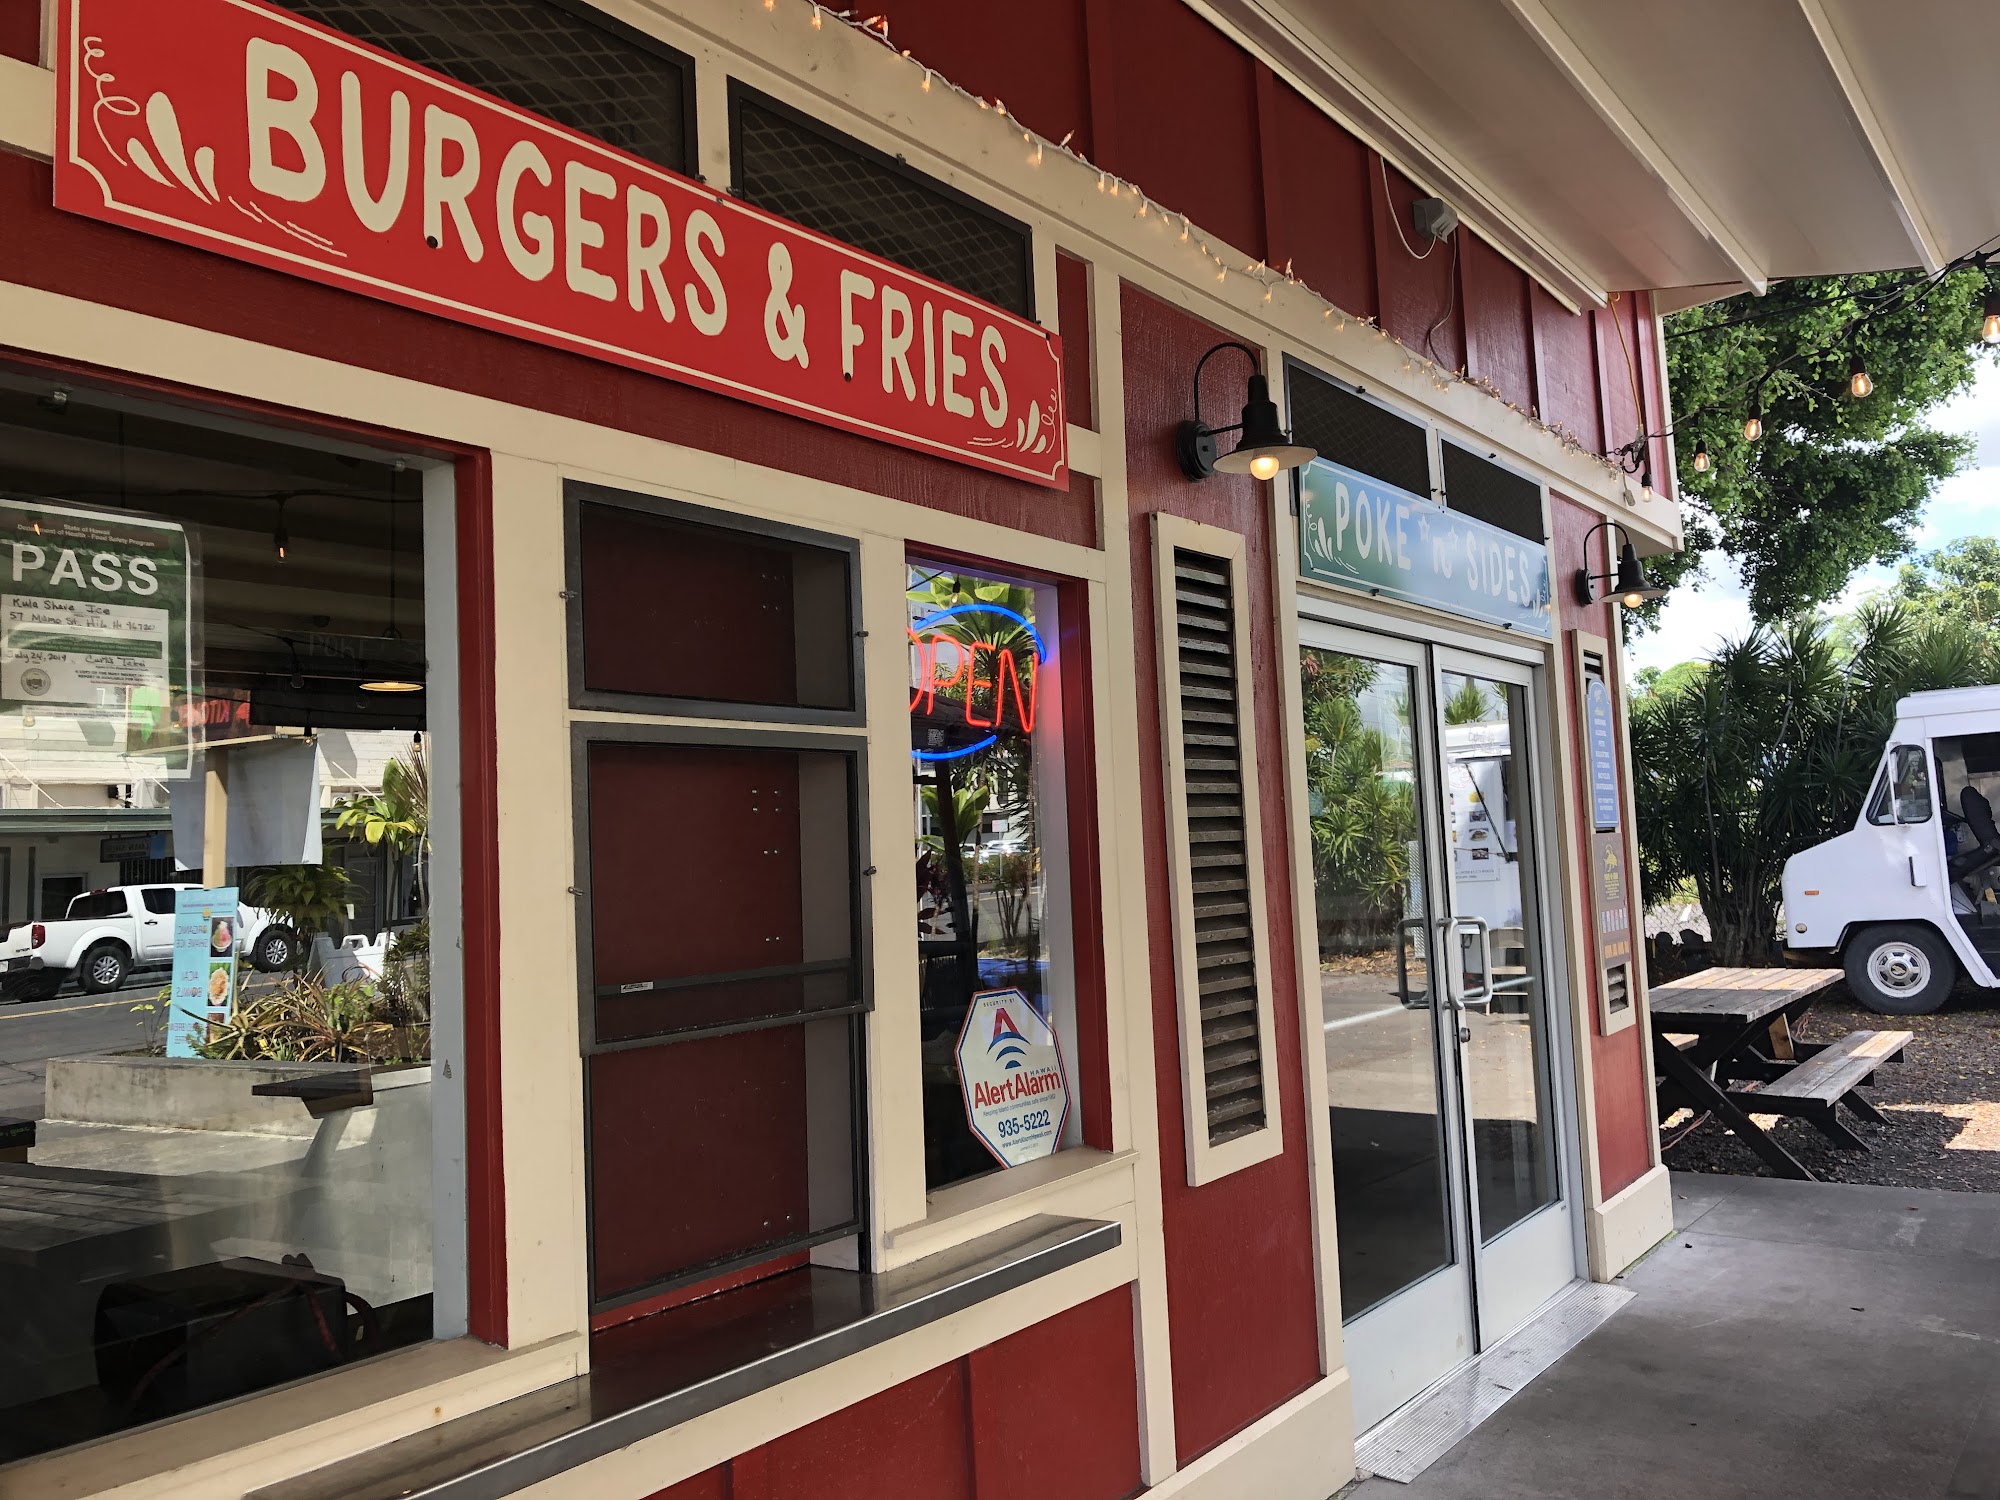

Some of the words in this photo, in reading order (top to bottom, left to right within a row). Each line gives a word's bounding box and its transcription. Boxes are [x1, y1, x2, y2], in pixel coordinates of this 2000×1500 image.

[246, 37, 727, 336] BURGERS
[764, 242, 808, 369] &
[840, 269, 1009, 428] FRIES
[17, 523, 56, 535] Depament
[129, 538, 155, 547] Program
[1335, 482, 1411, 570] POKE
[1466, 531, 1531, 607] SIDES
[12, 544, 159, 596] PASS
[10, 611, 23, 620] 57
[85, 604, 111, 615] Ice
[1030, 1065, 1057, 1076] HAWAII
[998, 1109, 1051, 1138] 935-5222
